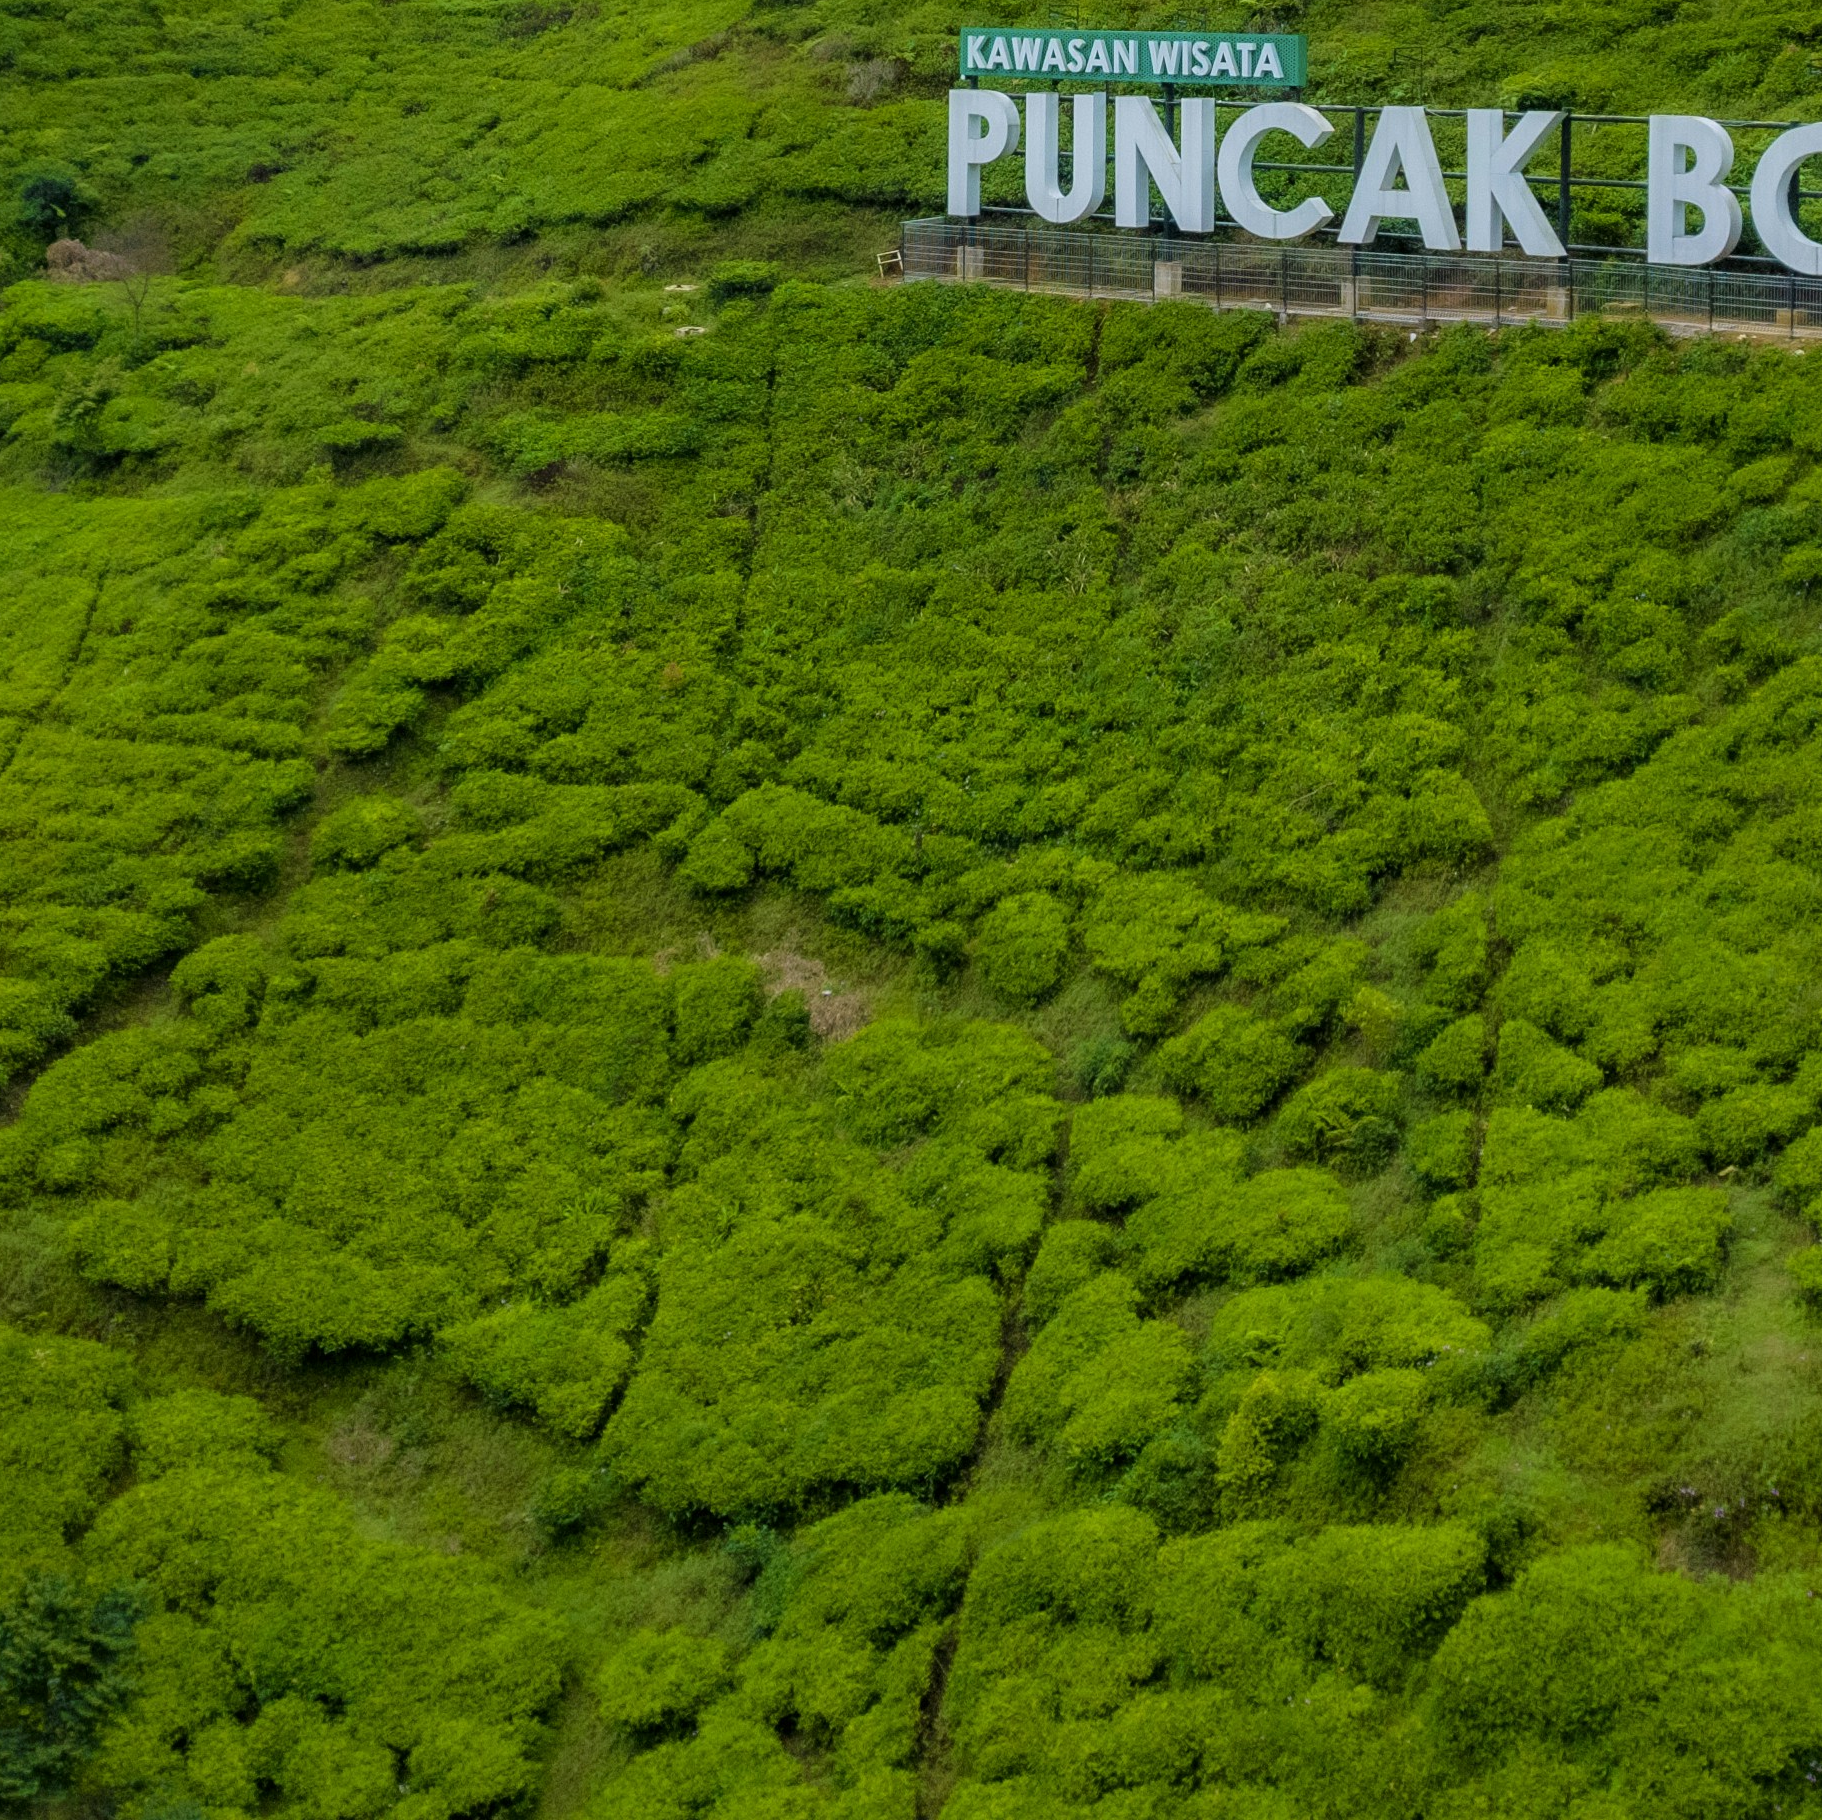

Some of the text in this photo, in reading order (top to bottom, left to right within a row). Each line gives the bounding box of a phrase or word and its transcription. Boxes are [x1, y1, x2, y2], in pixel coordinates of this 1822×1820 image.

[966, 35, 1285, 78] KAWASAN WISATA
[947, 88, 1567, 257] PUNCAK
